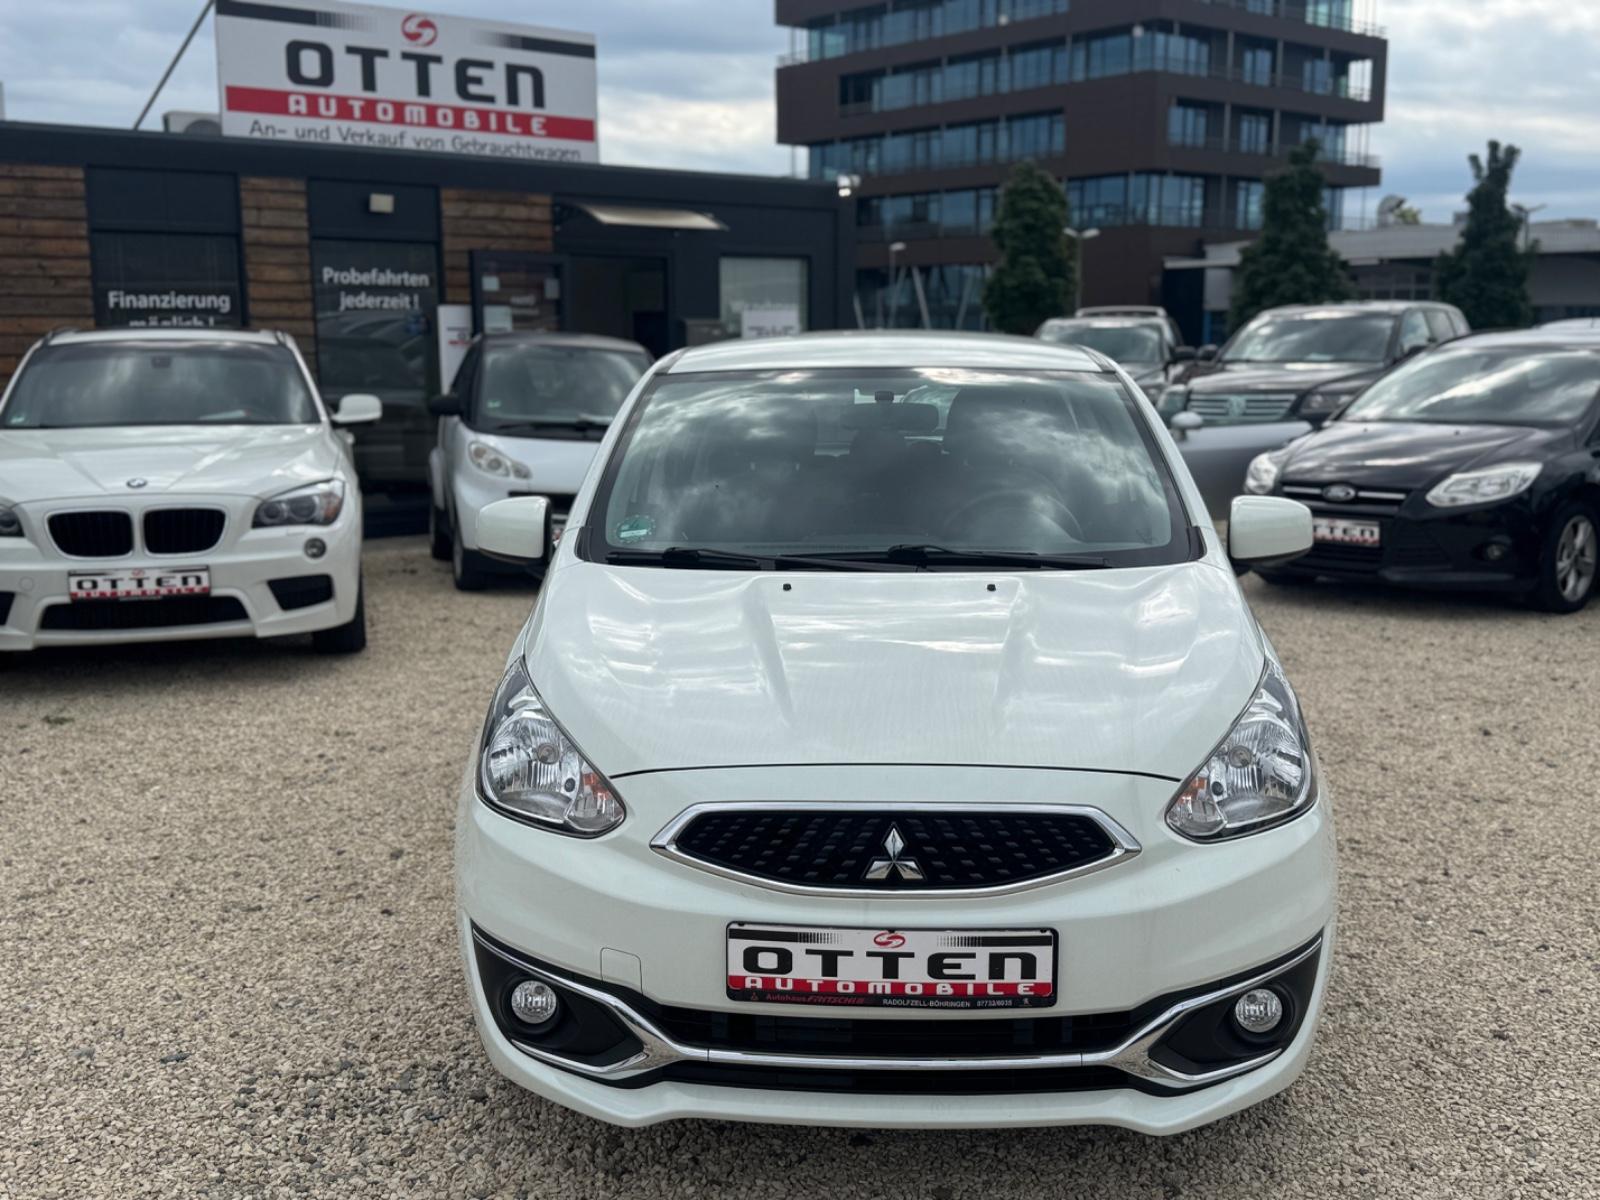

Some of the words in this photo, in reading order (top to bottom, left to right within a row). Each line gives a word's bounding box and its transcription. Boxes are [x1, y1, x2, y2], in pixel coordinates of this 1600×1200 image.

[285, 39, 546, 109] OTTEN
[287, 93, 547, 137] AUTOMOBILE
[250, 119, 287, 136] An-
[295, 125, 331, 141] und
[337, 125, 408, 147] Verkauf
[413, 136, 445, 150] von
[452, 135, 581, 162] Gebrauchtwagen
[322, 266, 430, 287] Probefahrten
[107, 290, 231, 313] Finanzierung
[339, 291, 411, 312] jederzeit
[76, 575, 202, 590] OTTEN
[742, 946, 1037, 980] OTTEN
[745, 976, 1035, 996] AUTOMOBILE
